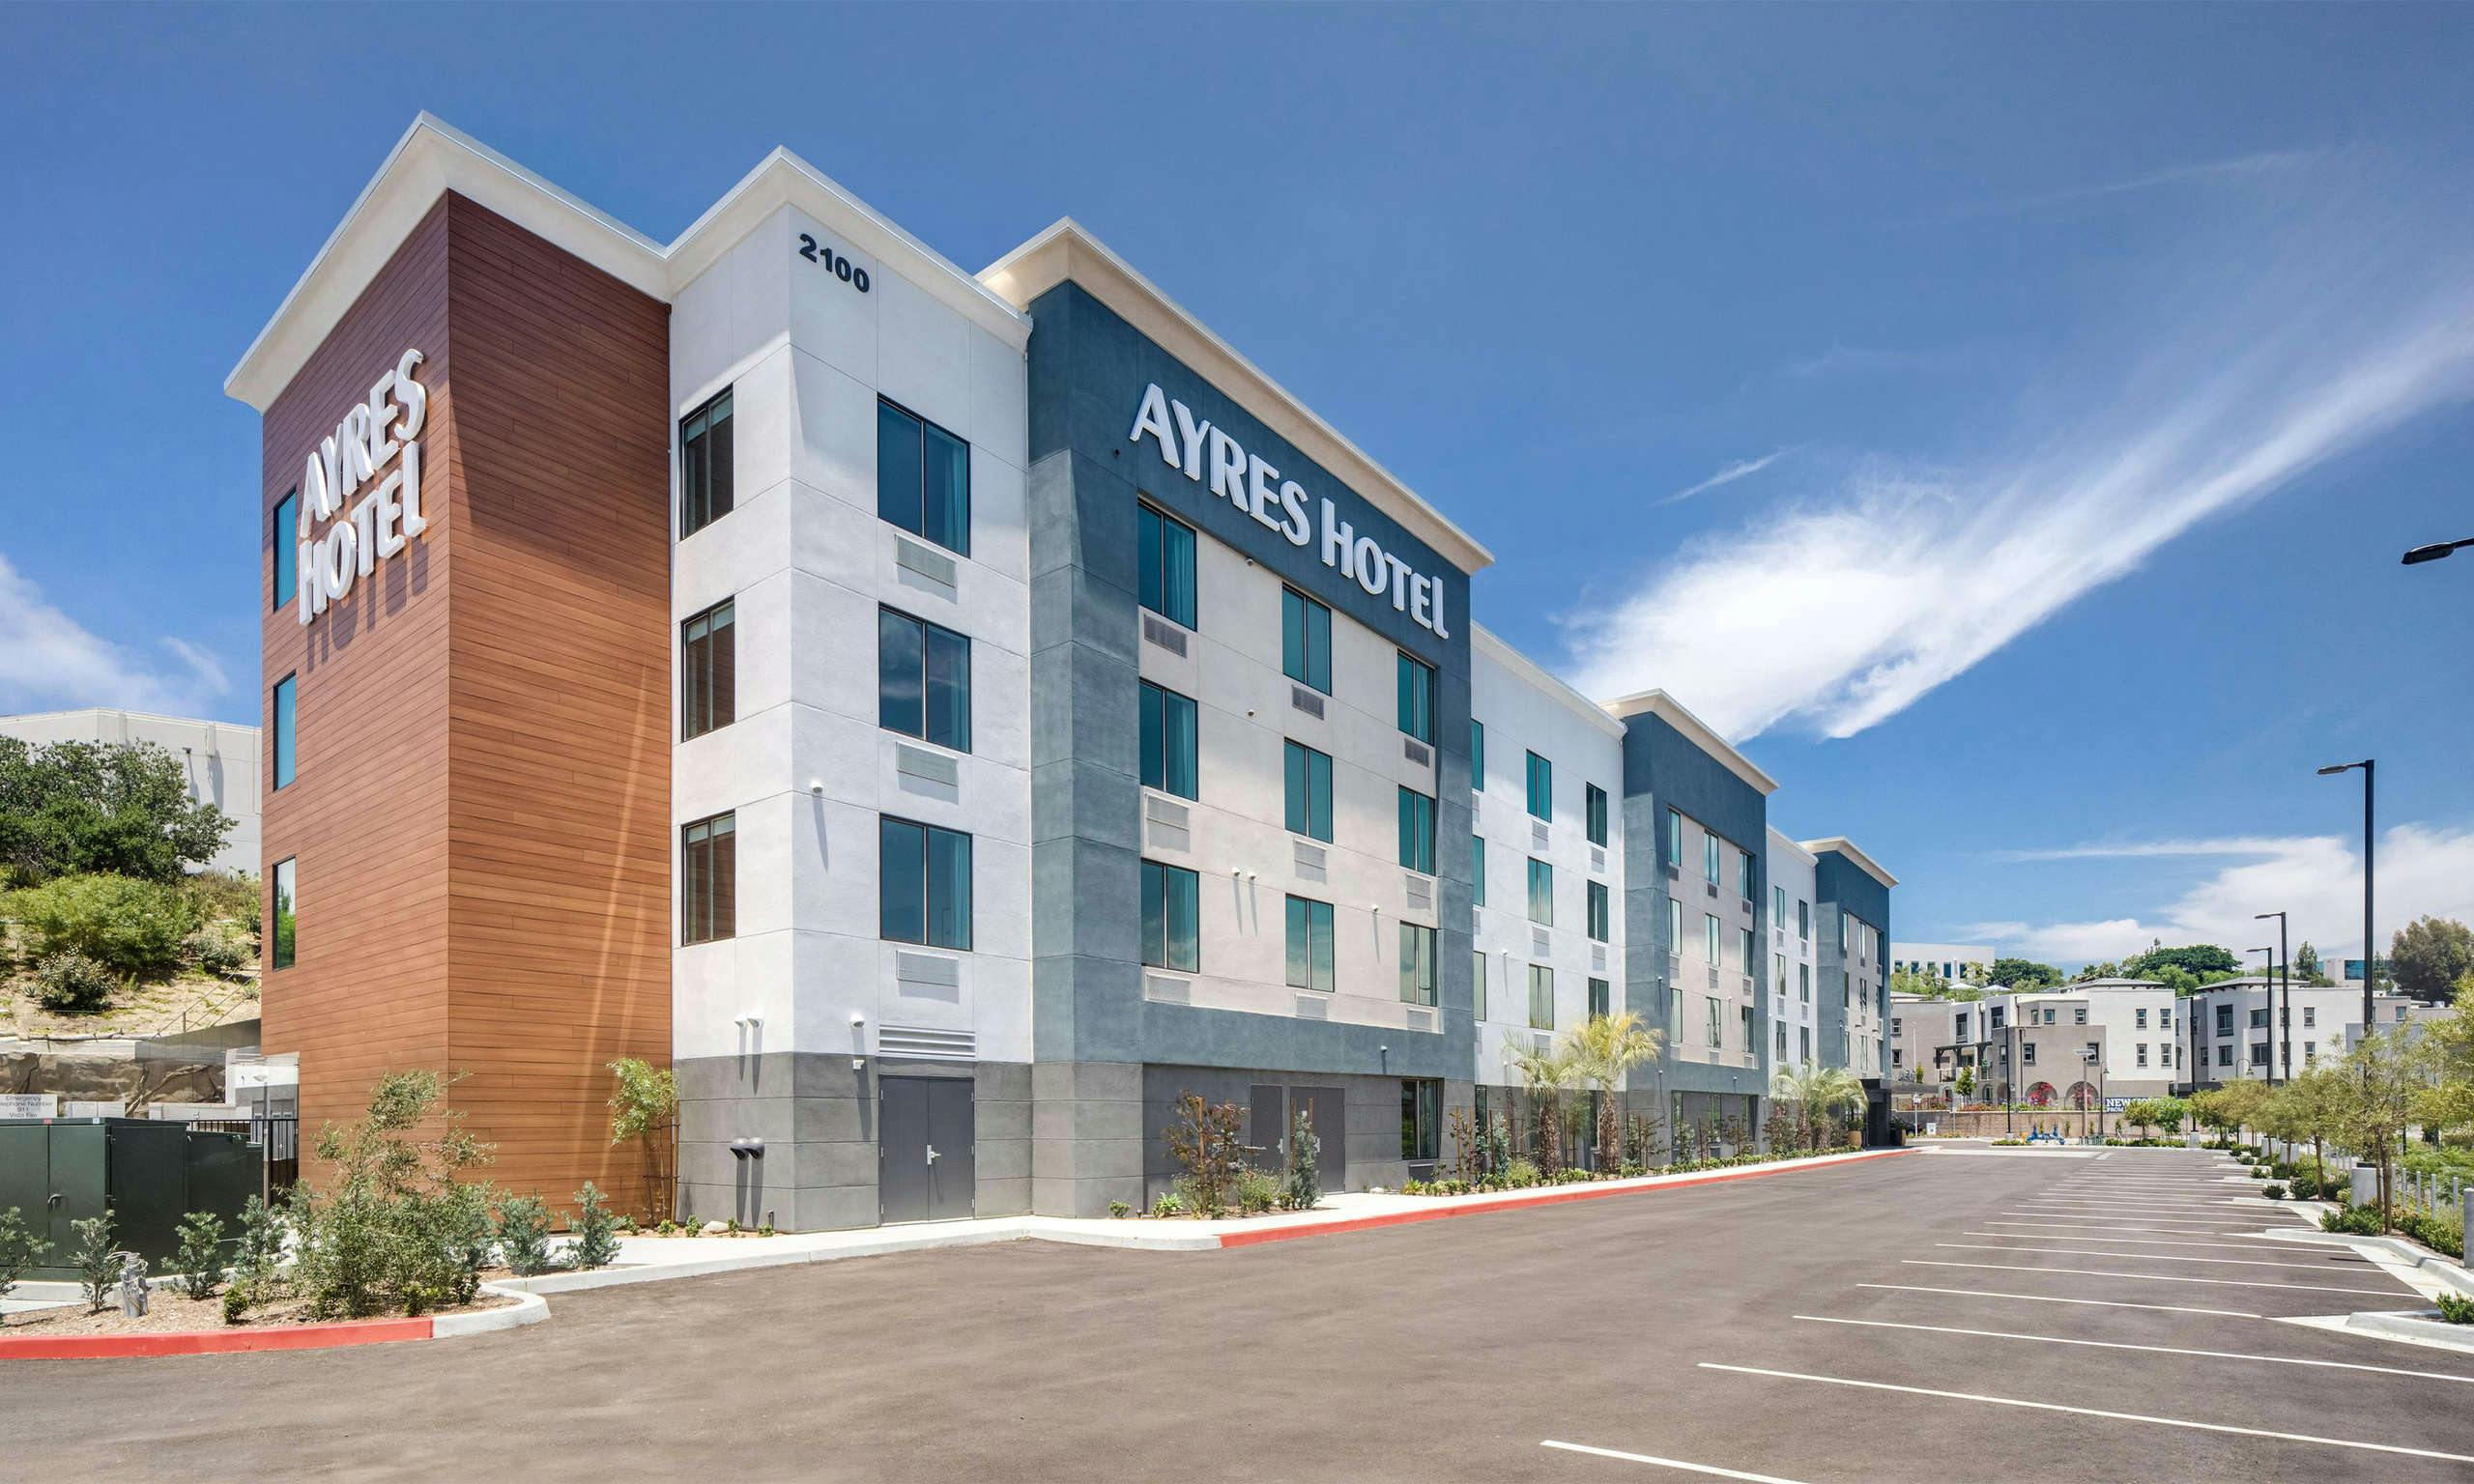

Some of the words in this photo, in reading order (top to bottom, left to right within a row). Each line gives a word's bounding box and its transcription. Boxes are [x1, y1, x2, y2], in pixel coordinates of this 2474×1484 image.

[799, 233, 870, 293] 2100
[299, 441, 427, 626] HOTEL
[300, 349, 425, 538] AYRES
[1129, 383, 1310, 546] AYRES
[1321, 497, 1449, 640] HOTEL
[2106, 1098, 2130, 1107] NEW
